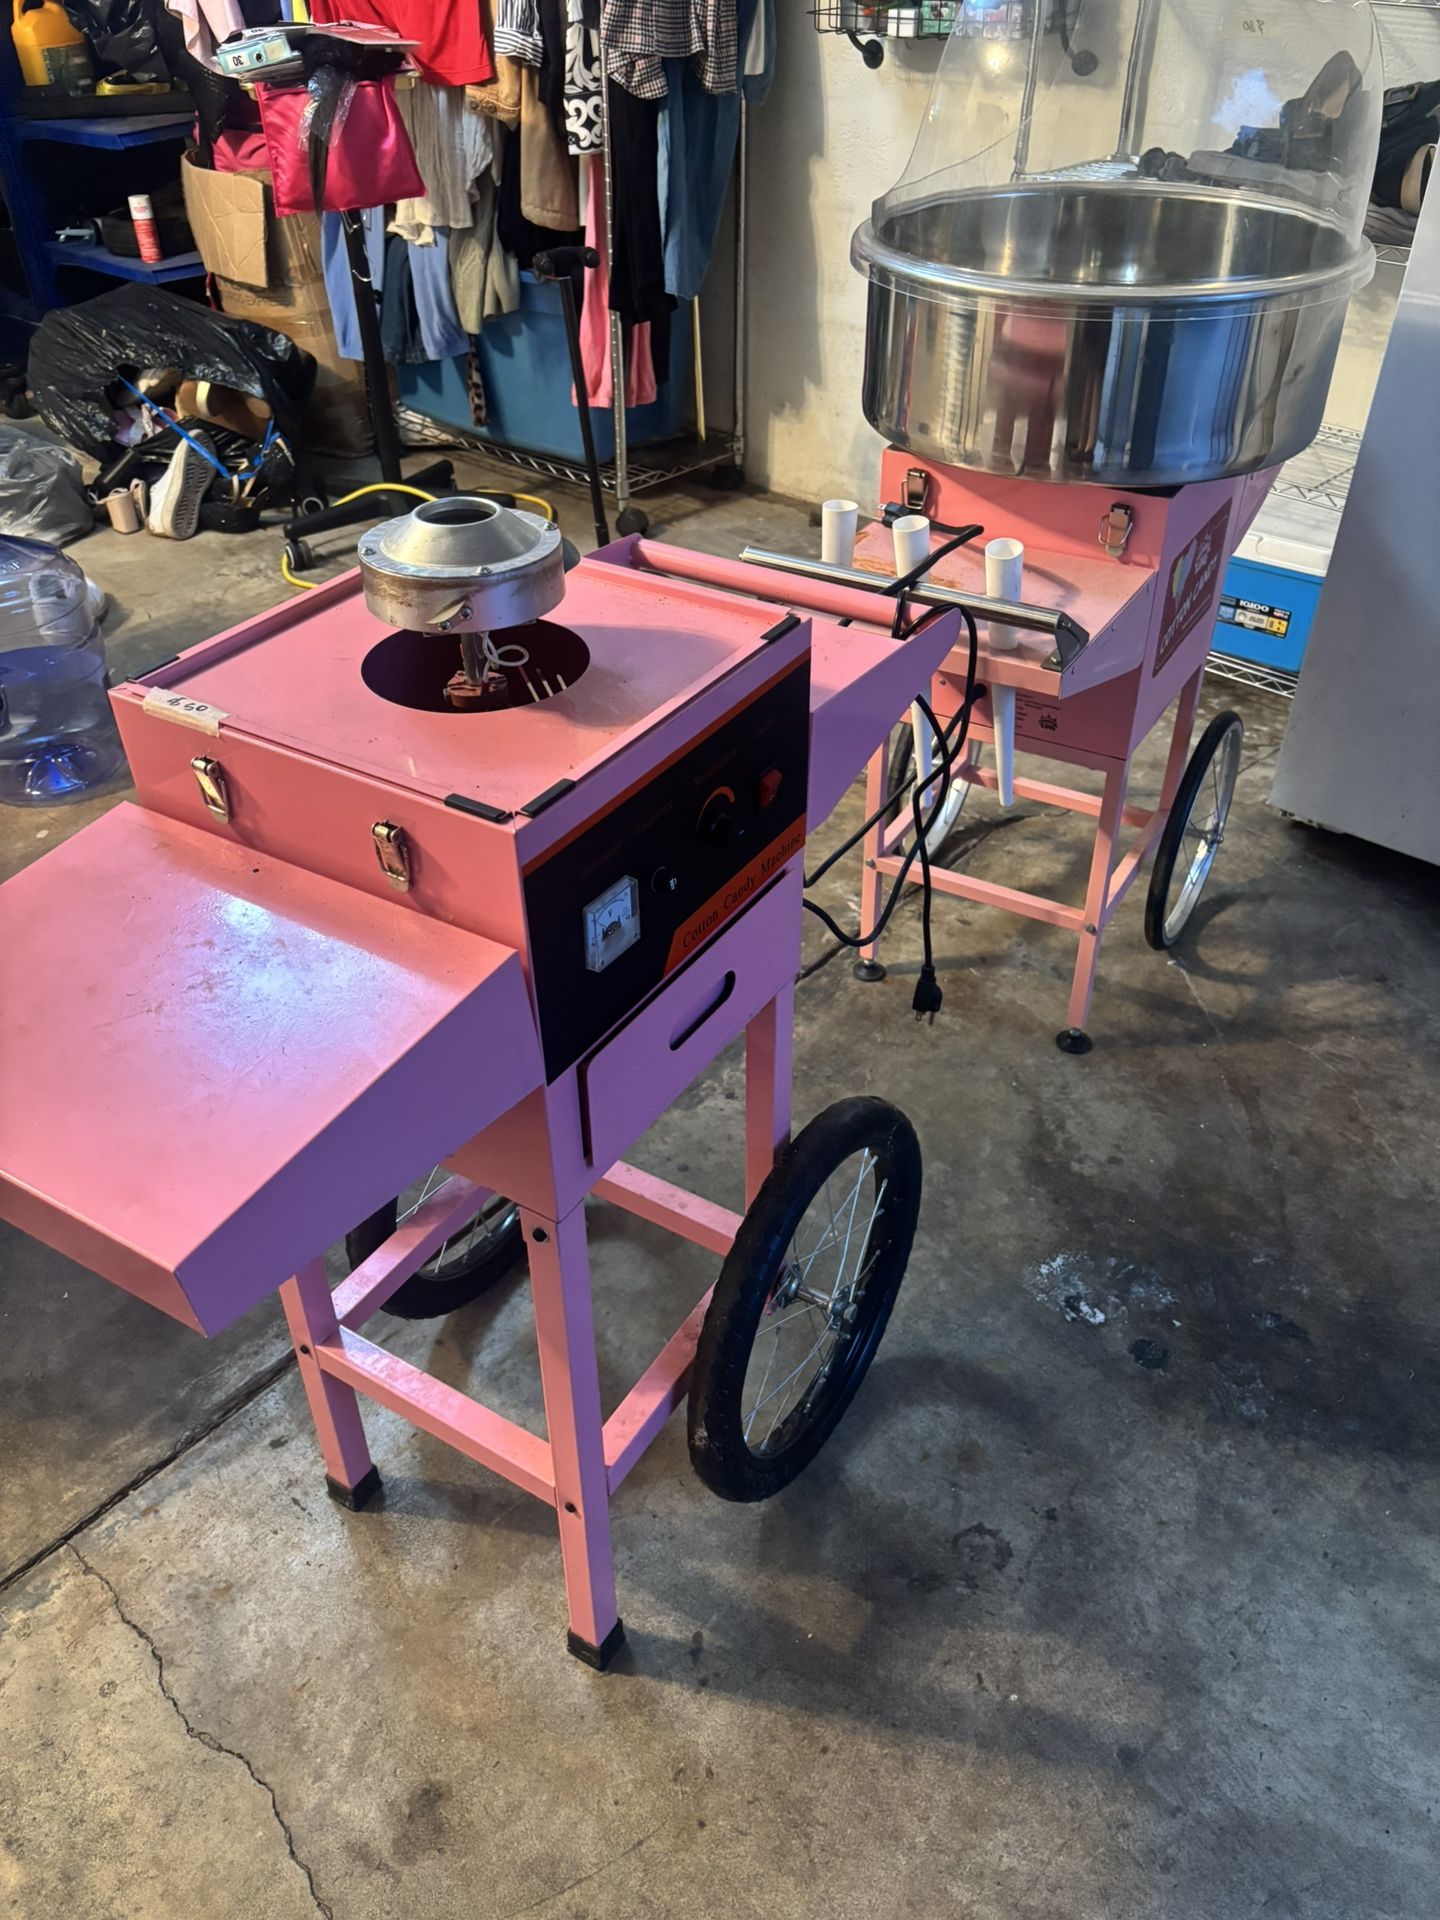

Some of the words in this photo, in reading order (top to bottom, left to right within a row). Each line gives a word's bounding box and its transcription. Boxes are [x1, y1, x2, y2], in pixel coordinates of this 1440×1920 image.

[1160, 592, 1193, 655] COTTON
[1193, 553, 1219, 601] CANDY
[682, 910, 719, 948] Cotton
[724, 873, 757, 909] Candy
[760, 832, 801, 876] Machine
